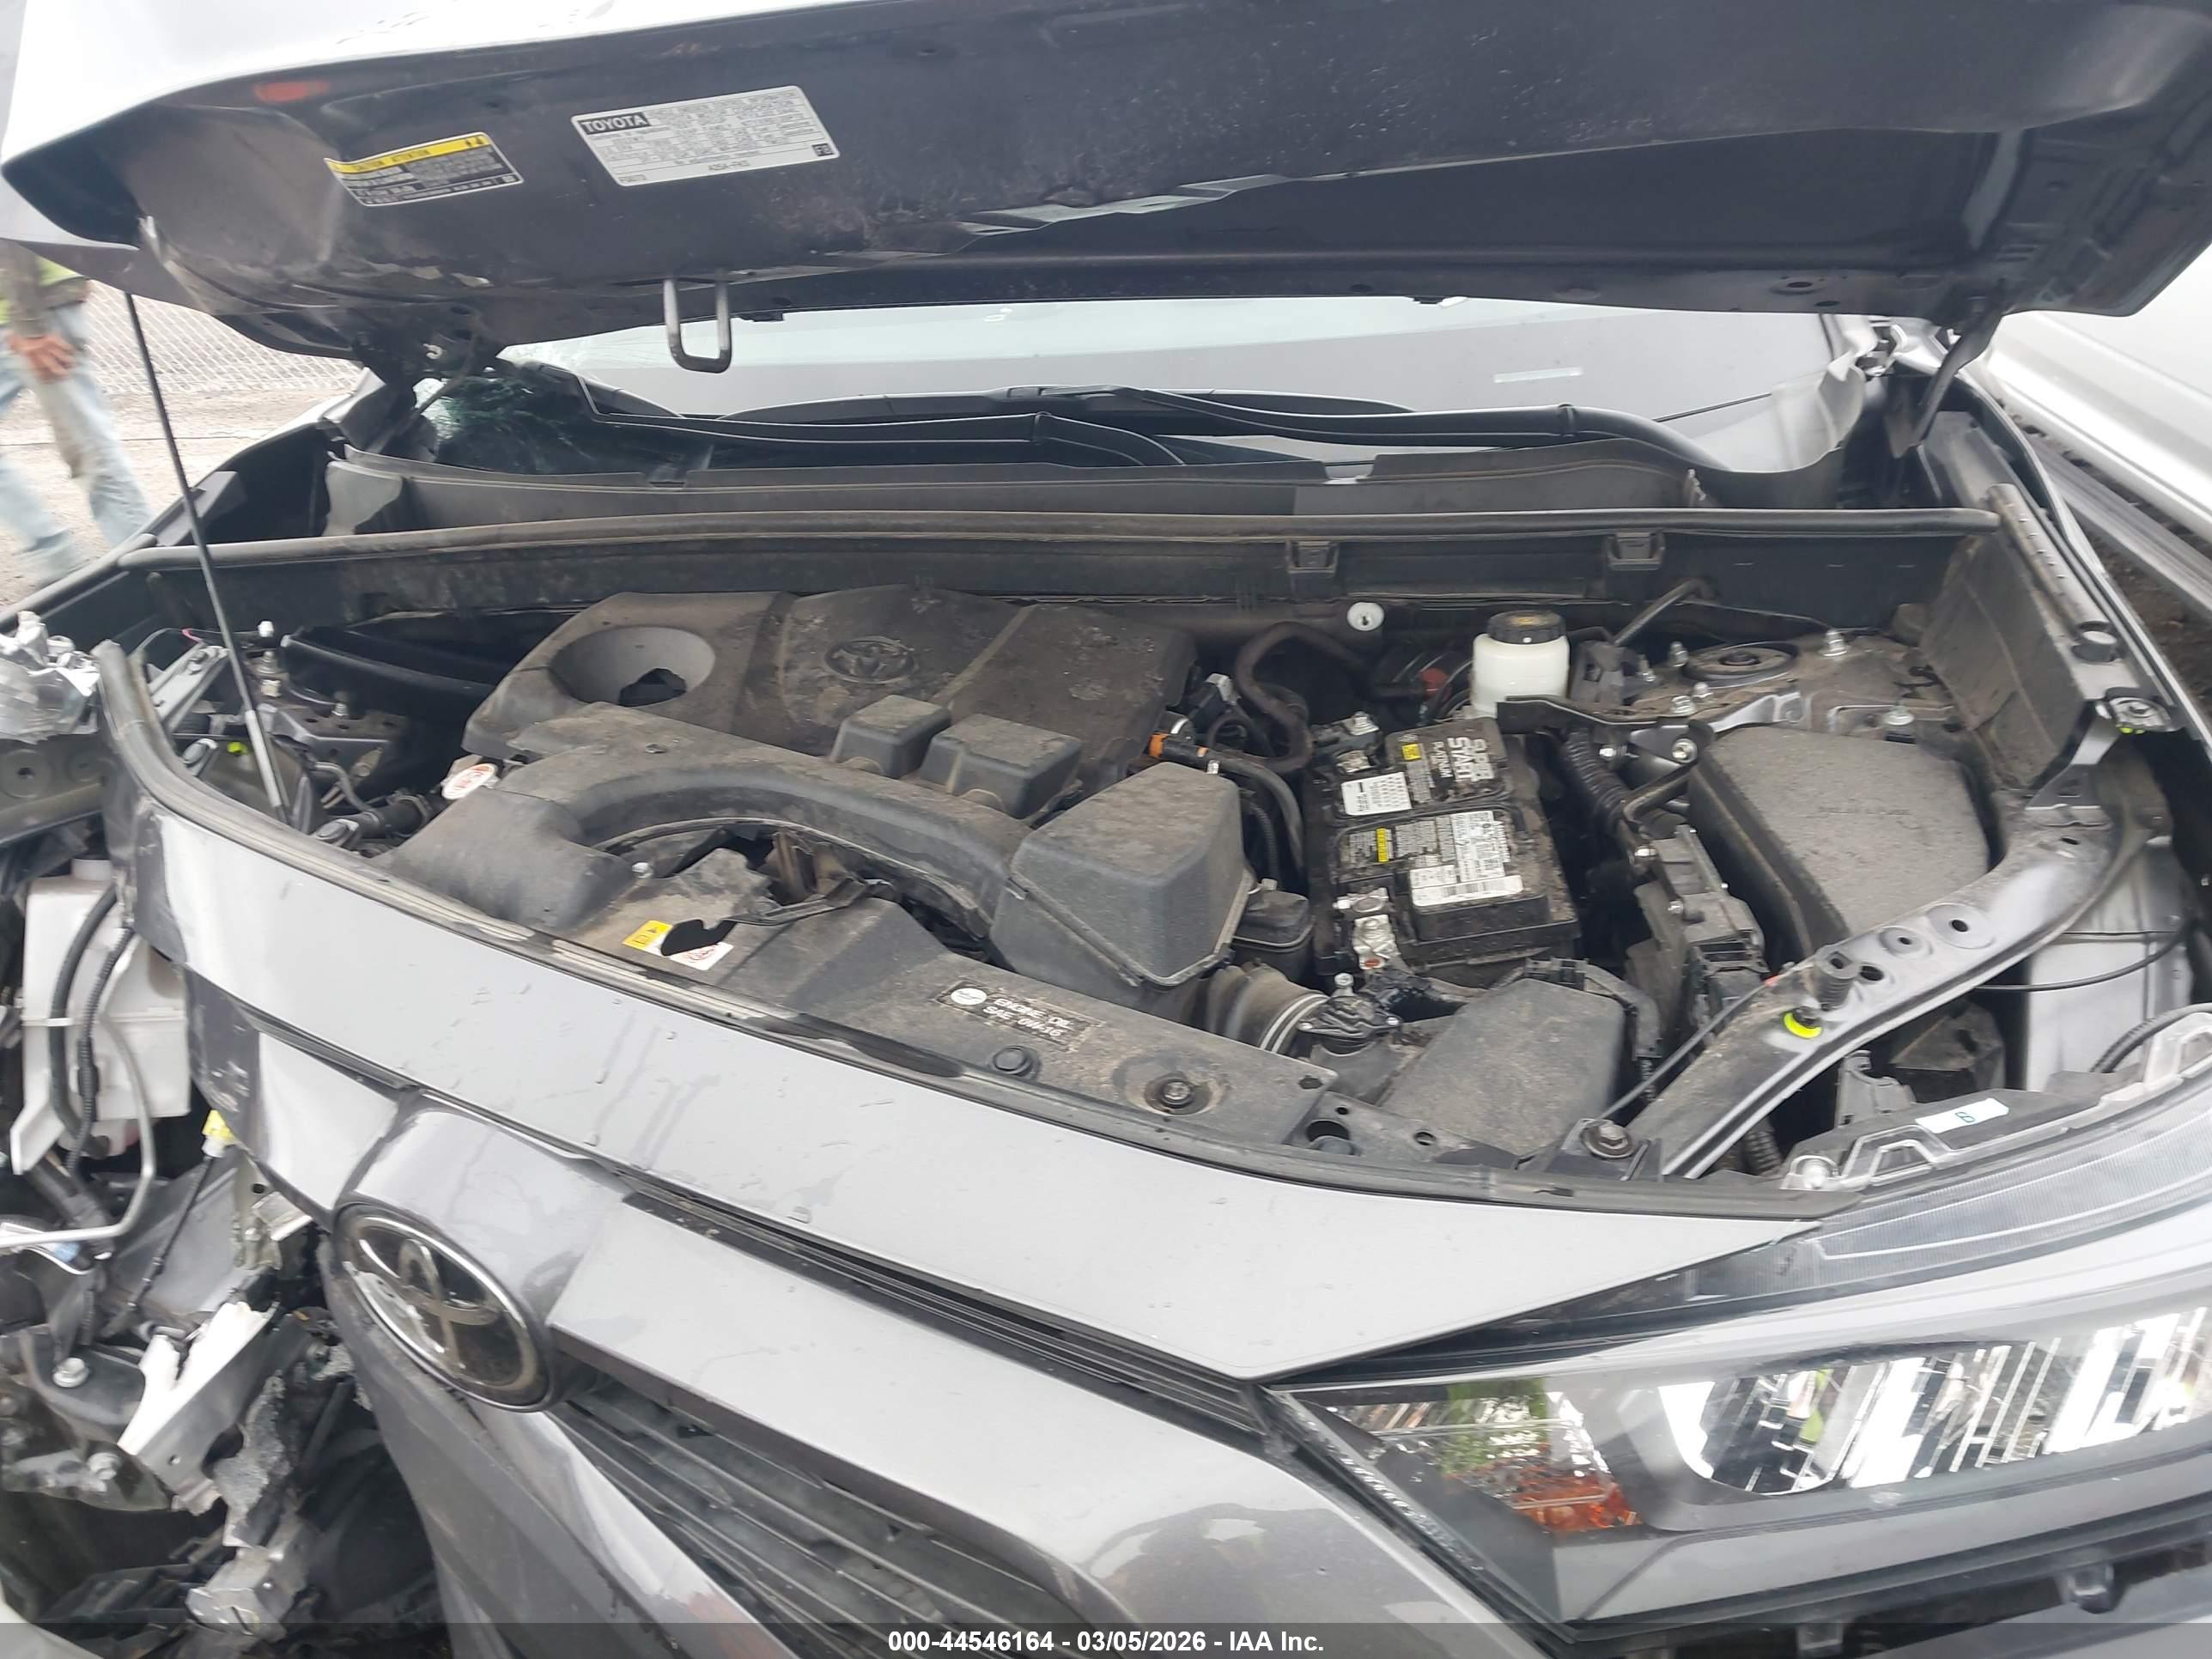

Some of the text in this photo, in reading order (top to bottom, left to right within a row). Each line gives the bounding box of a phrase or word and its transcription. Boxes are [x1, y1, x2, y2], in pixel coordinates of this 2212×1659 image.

[580, 114, 648, 132] TOYOTA
[1431, 741, 1454, 778] PLATINUM
[1447, 737, 1472, 781] START
[1468, 738, 1494, 782] SUPER
[982, 1006, 1065, 1037] SAE 0W-16
[994, 998, 1073, 1030] ENGINE OIL
